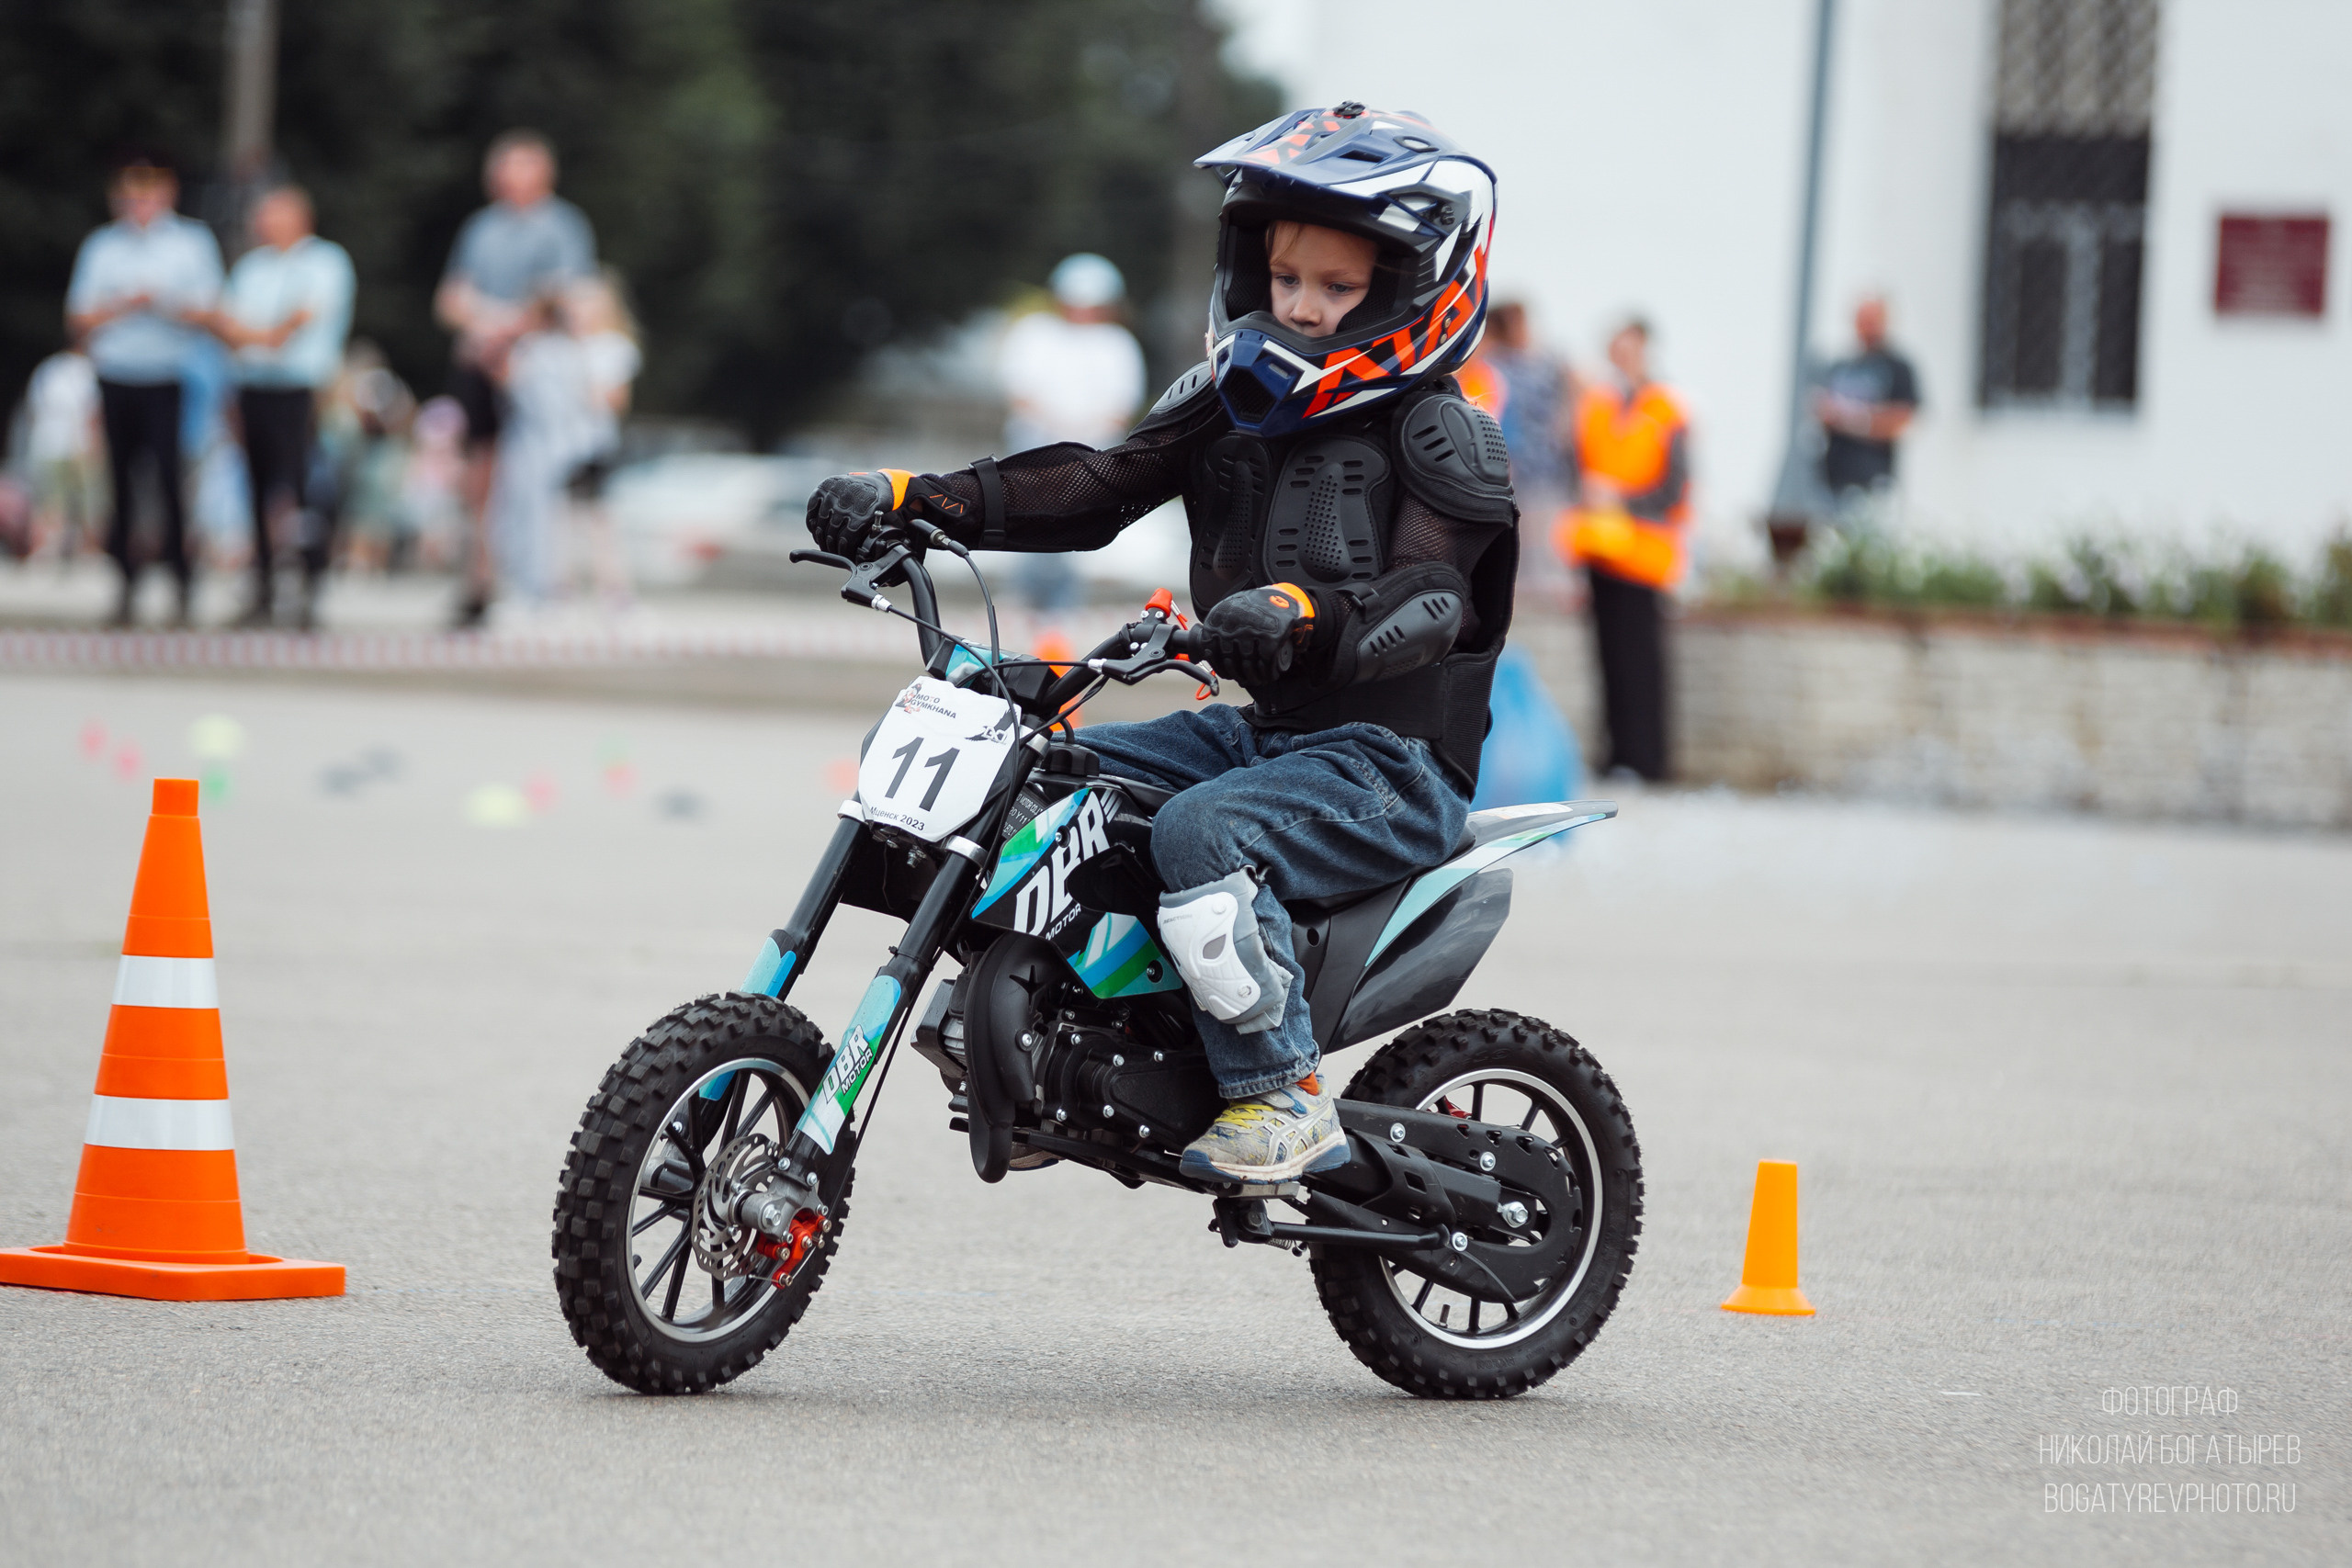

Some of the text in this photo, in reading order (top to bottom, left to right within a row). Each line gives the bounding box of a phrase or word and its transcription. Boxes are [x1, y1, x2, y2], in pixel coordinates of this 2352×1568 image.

[910, 699, 957, 719] GYMKHANA
[915, 694, 941, 704] MOTO
[884, 736, 960, 812] 11
[899, 814, 925, 831] 2023
[1013, 791, 1111, 937] DBR
[1045, 903, 1082, 941] MOTOR
[822, 1024, 869, 1104] DBR
[841, 1048, 873, 1095] MOTOR
